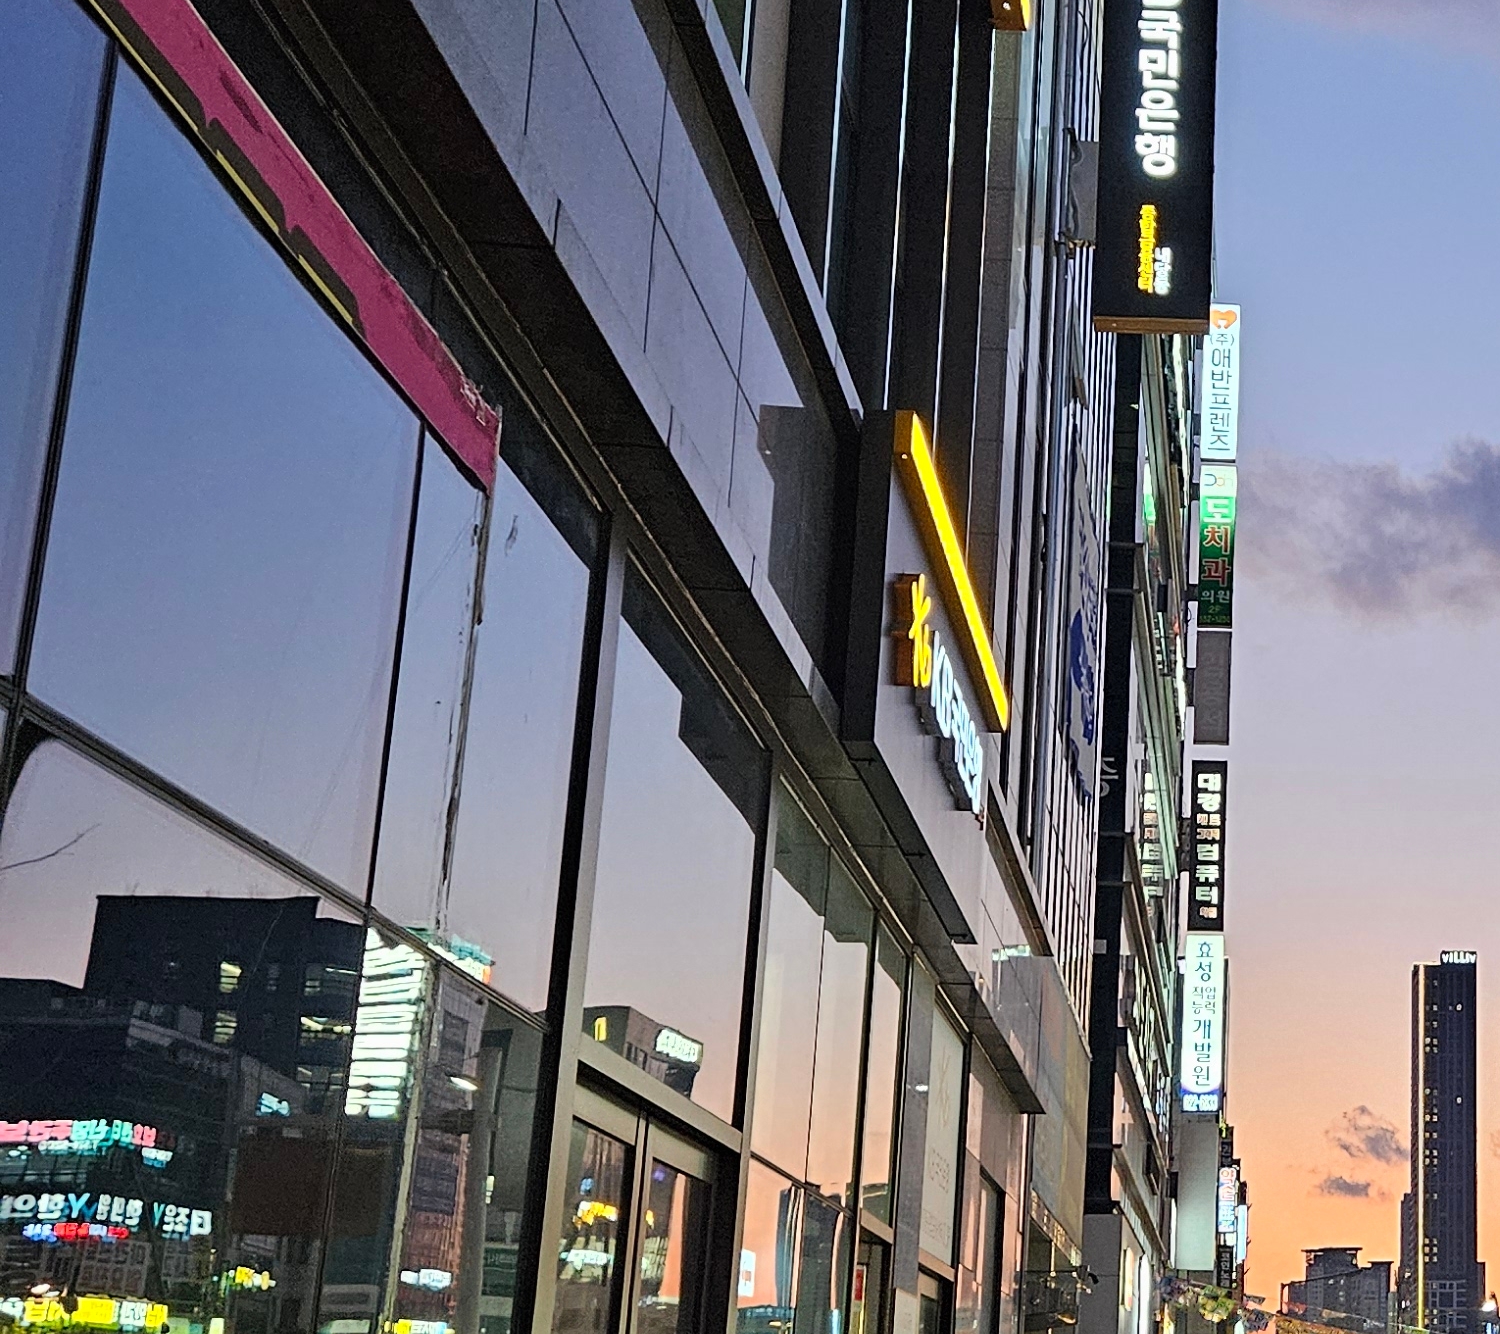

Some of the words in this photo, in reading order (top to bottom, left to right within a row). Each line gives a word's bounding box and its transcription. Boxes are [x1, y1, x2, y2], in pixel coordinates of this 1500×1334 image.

[1195, 842, 1220, 905] 컴퓨터
[1194, 941, 1214, 983] 효성
[1191, 1018, 1212, 1087] 개발원
